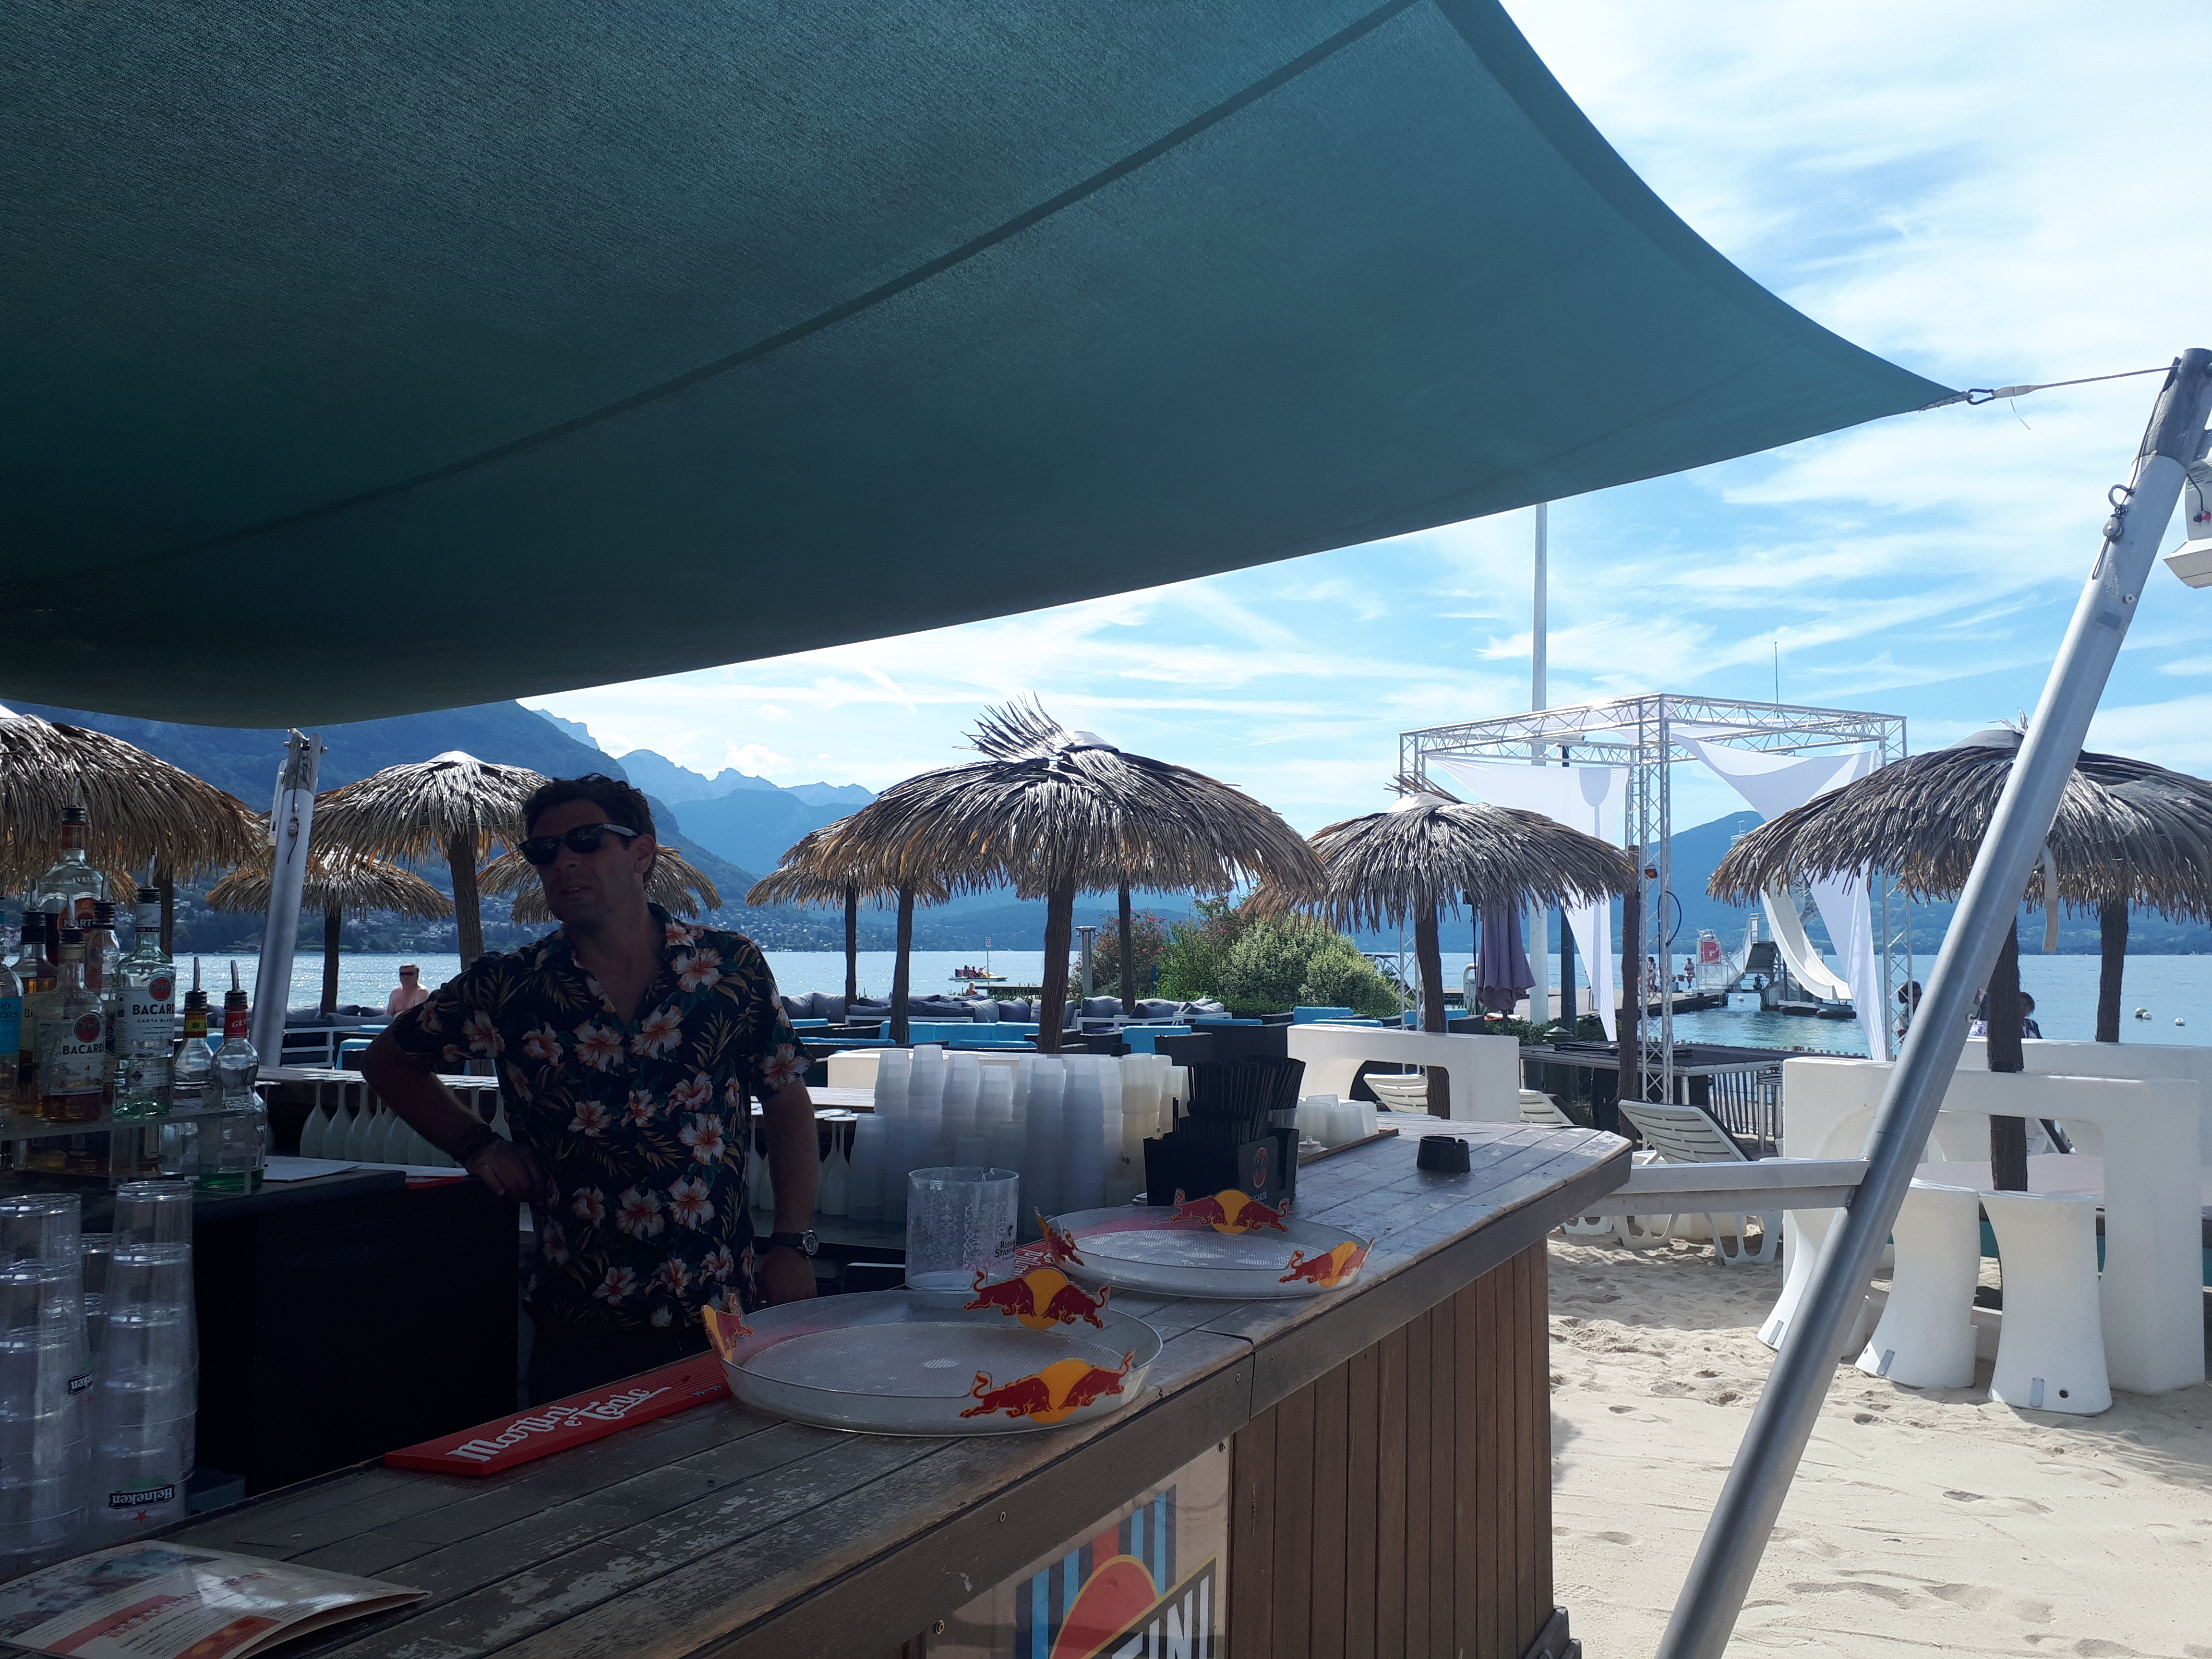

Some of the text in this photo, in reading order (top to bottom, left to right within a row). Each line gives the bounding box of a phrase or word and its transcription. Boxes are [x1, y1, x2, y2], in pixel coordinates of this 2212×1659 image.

[132, 1003, 175, 1015] BACARD
[63, 1043, 105, 1055] BACARD
[446, 1406, 579, 1462] Martini
[567, 1387, 672, 1420] Tonic
[112, 1488, 173, 1505] Heineken
